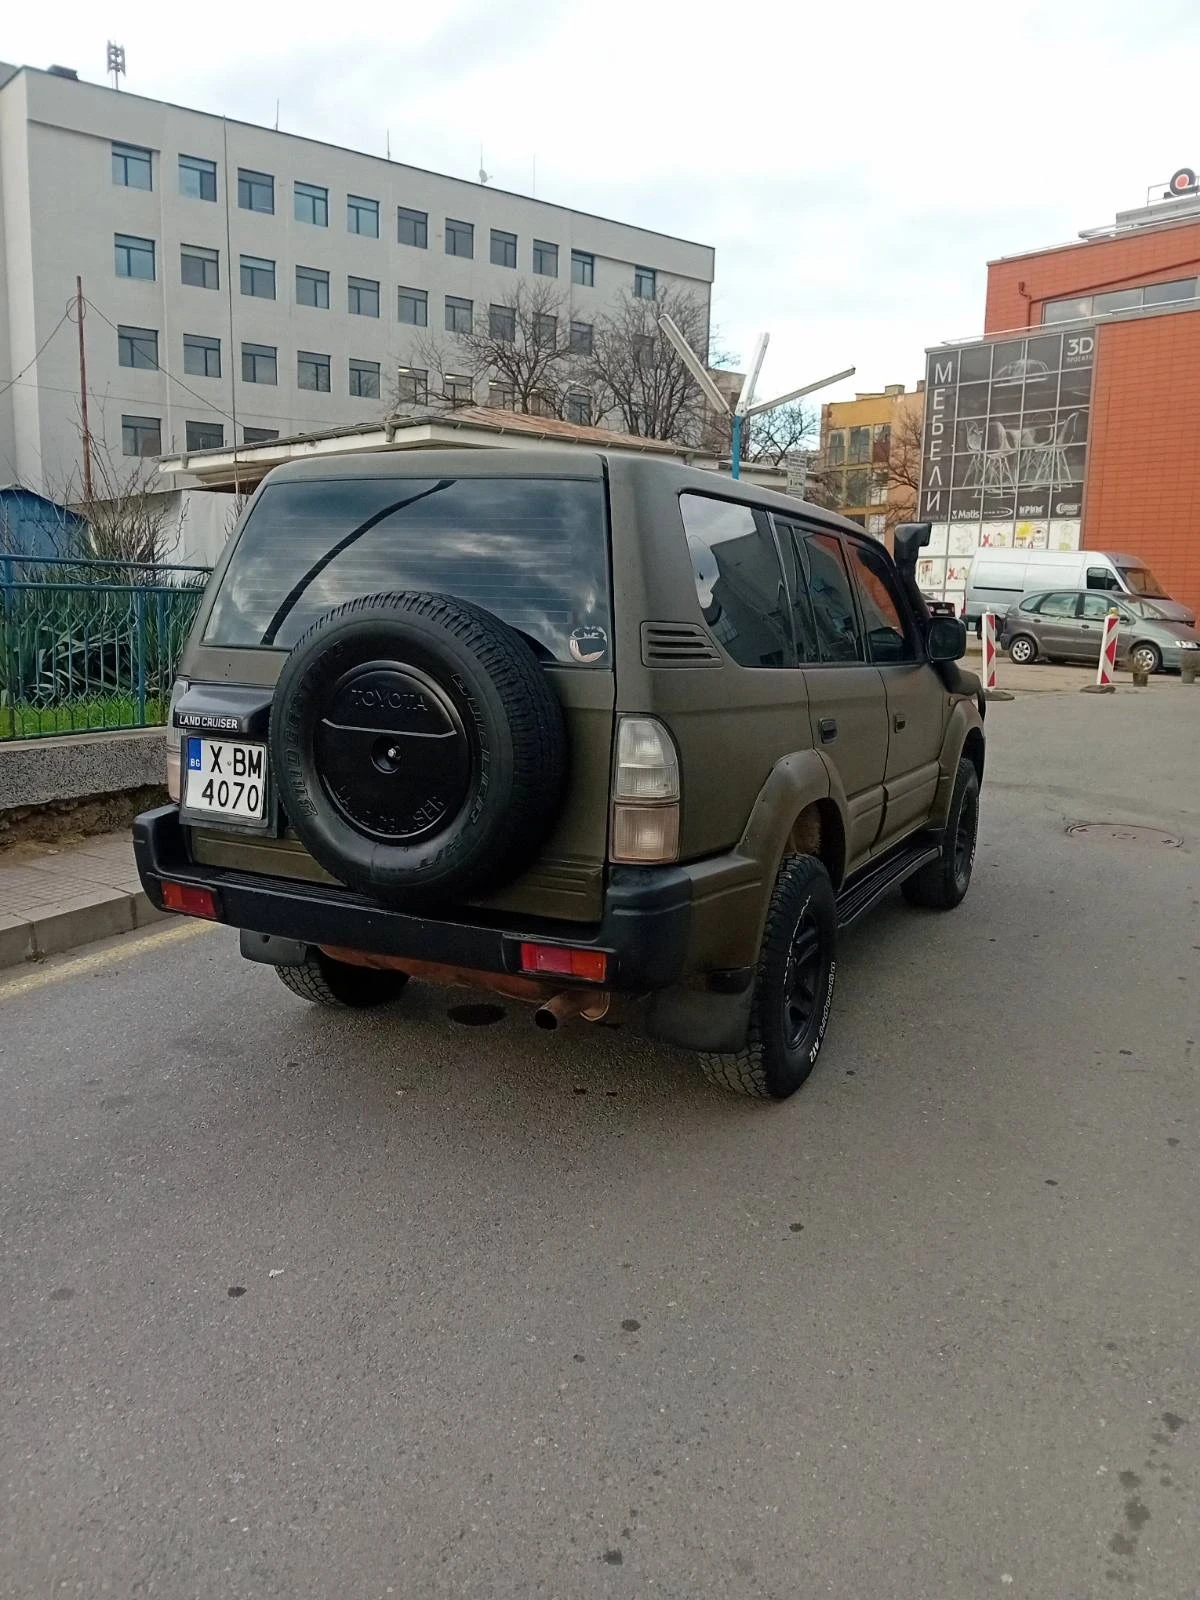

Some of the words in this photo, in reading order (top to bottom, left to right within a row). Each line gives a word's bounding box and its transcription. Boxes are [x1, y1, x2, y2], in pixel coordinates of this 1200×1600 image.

[1067, 337, 1094, 356] 3D
[926, 361, 952, 512] МЕБЕЛИ
[351, 688, 429, 712] TOYOTA
[179, 715, 201, 727] LAND
[201, 717, 238, 729] CRUISER
[190, 758, 201, 768] BG
[209, 744, 223, 774] X
[233, 747, 263, 780] BM
[202, 778, 259, 812] 4070
